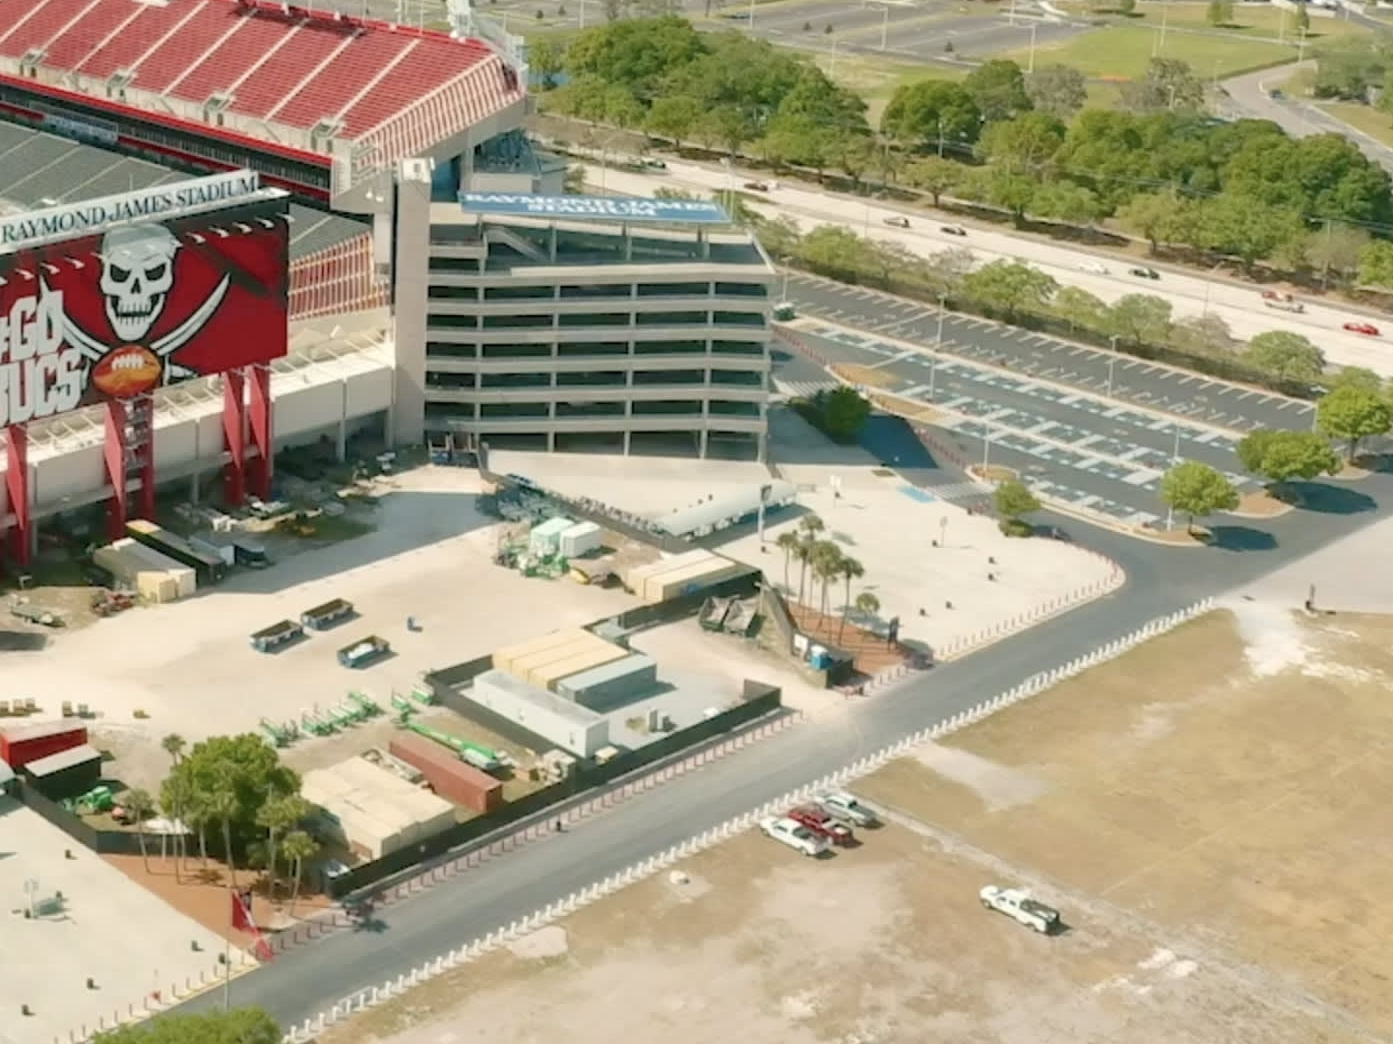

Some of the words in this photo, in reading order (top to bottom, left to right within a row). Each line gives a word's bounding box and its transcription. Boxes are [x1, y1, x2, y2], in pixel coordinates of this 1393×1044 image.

[1, 211, 107, 244] RAYMOND
[108, 195, 173, 222] JAMES
[176, 175, 258, 206] STADIUM
[464, 194, 614, 208] RAYMOND
[619, 200, 718, 212] JAMES
[527, 203, 656, 217] STADIUM
